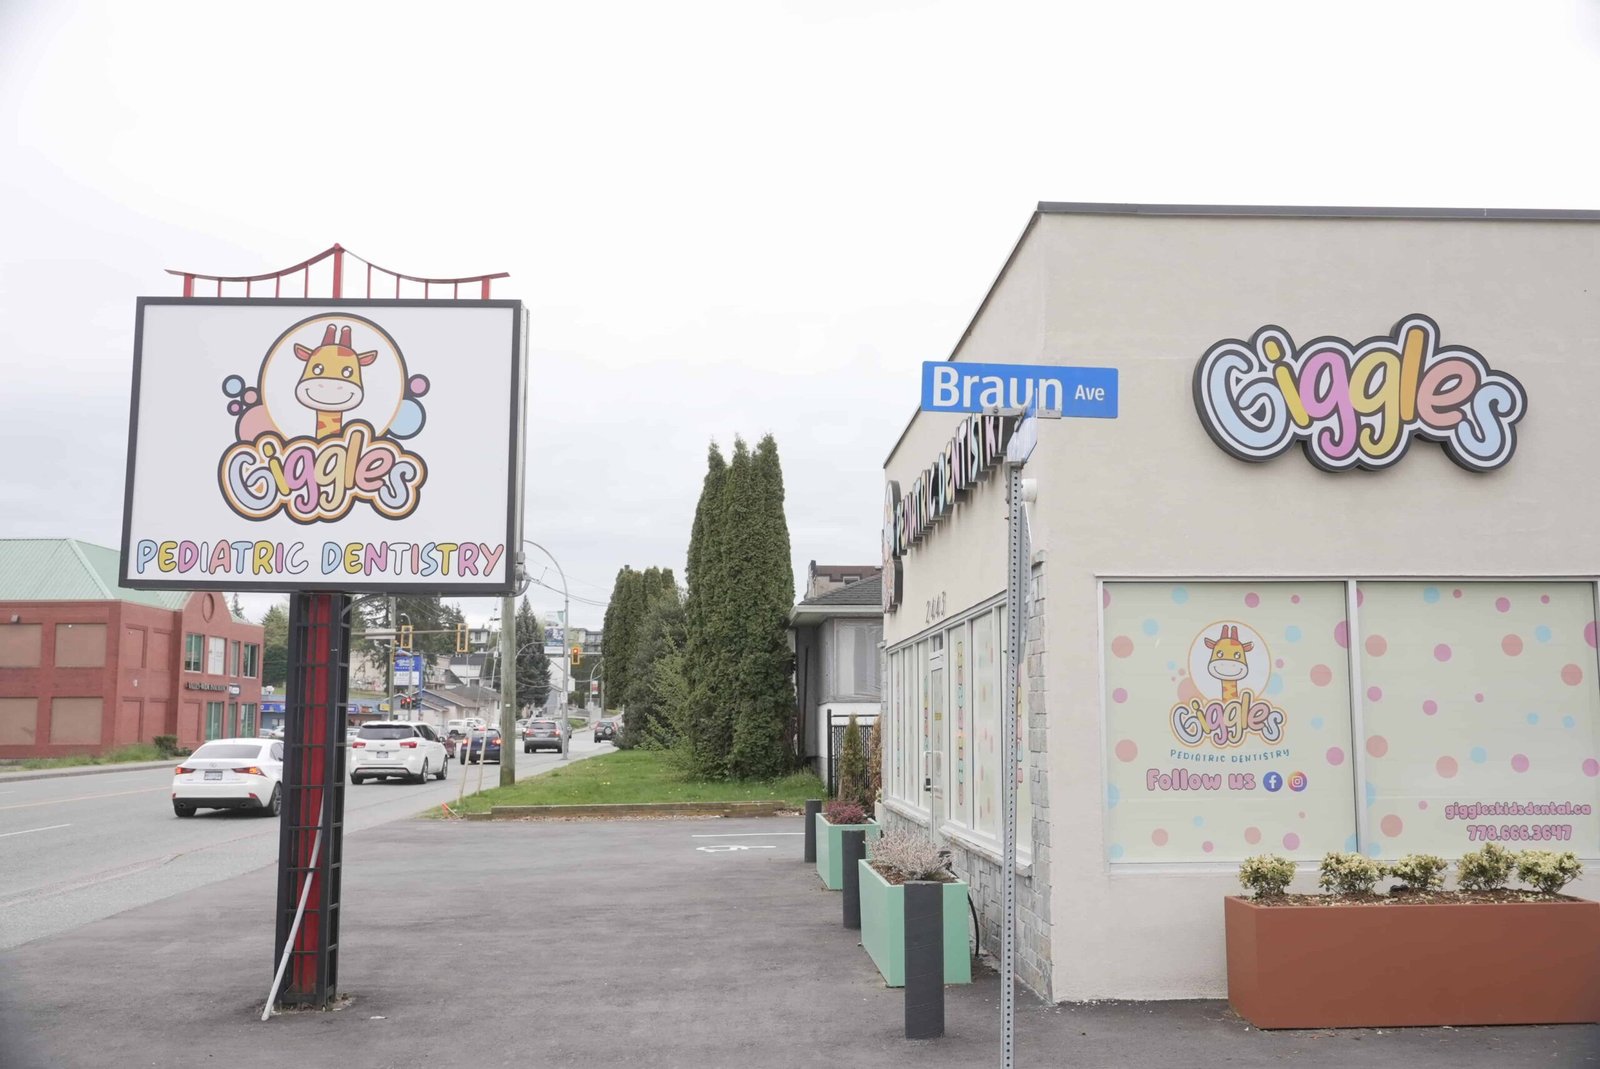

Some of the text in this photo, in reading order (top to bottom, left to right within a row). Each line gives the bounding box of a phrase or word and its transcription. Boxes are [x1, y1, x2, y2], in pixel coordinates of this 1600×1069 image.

[932, 366, 1105, 409] Braun Ave
[1206, 325, 1517, 459] Giggles
[226, 428, 417, 513] Giggles
[136, 539, 505, 578] PEDIATRIC DENTISTRY
[1172, 691, 1284, 746] Giggles
[1170, 748, 1290, 764] PEDIATRIC DENTISTRY
[1146, 768, 1257, 791] Follow us
[1445, 801, 1592, 820] giggleskidsdental.ca
[1466, 824, 1573, 842] 778.666.3647
